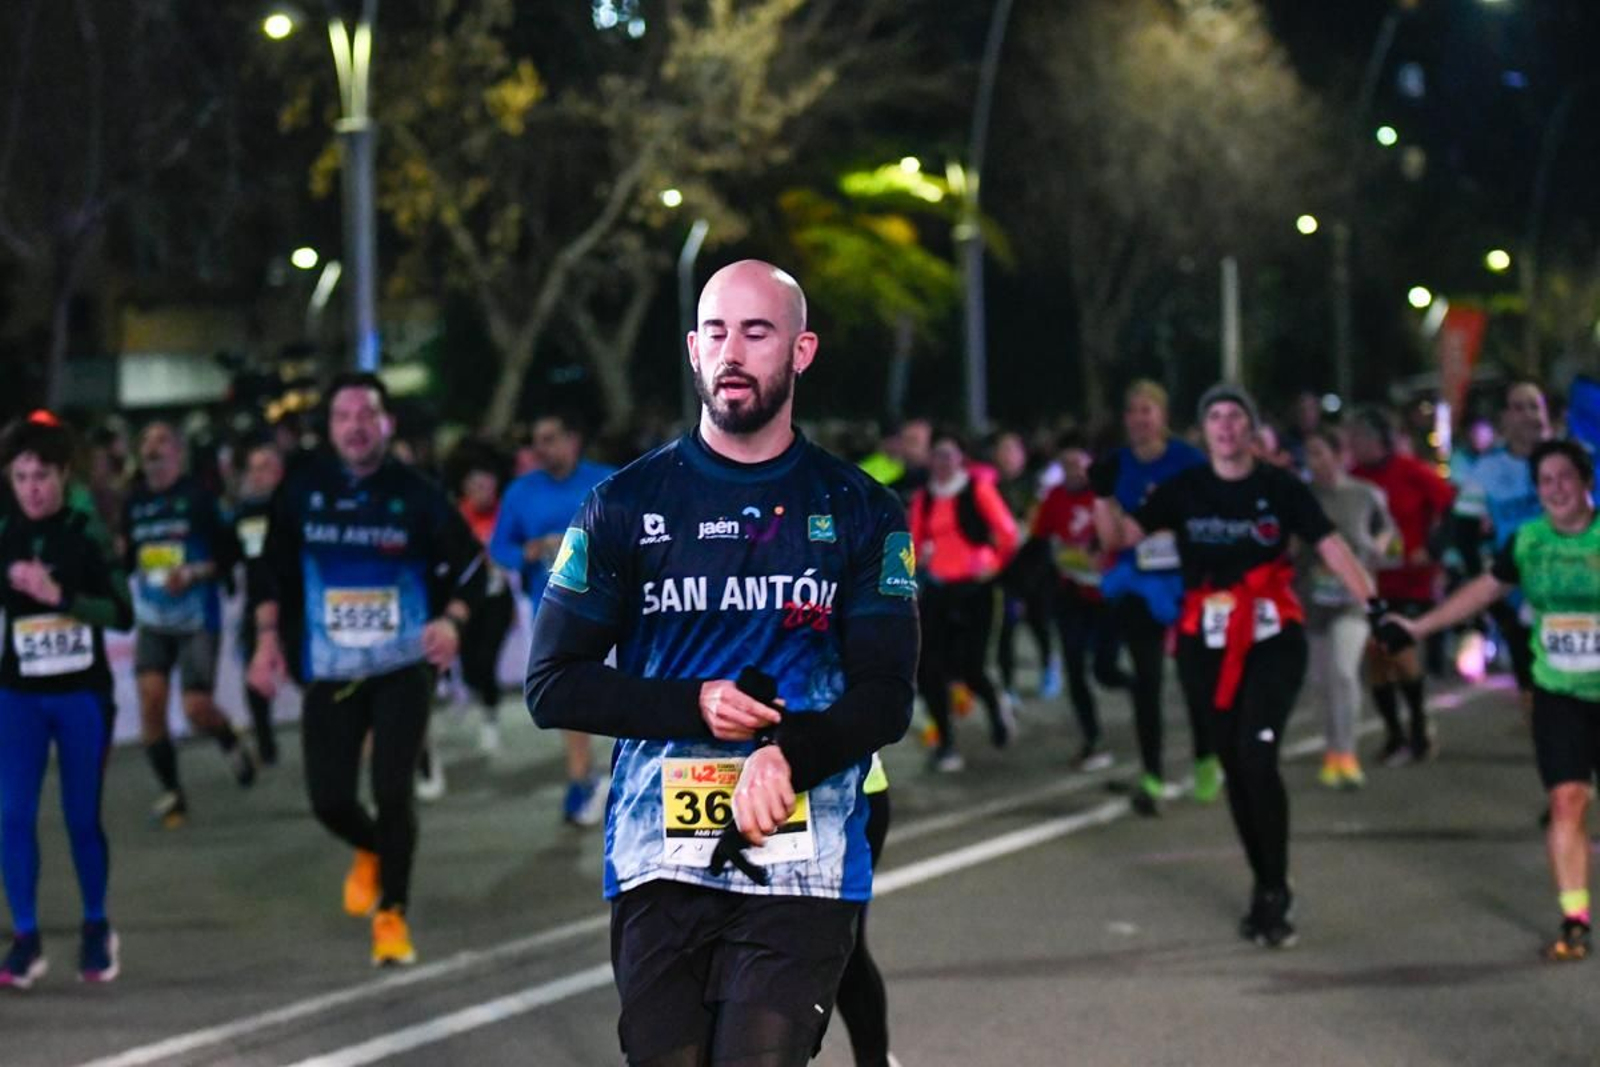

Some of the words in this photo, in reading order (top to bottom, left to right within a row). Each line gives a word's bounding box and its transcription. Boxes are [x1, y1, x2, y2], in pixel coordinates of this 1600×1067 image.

[697, 516, 738, 539] jaén
[642, 577, 709, 615] SAN
[719, 568, 837, 614] ANTÓN
[691, 764, 717, 783] 42
